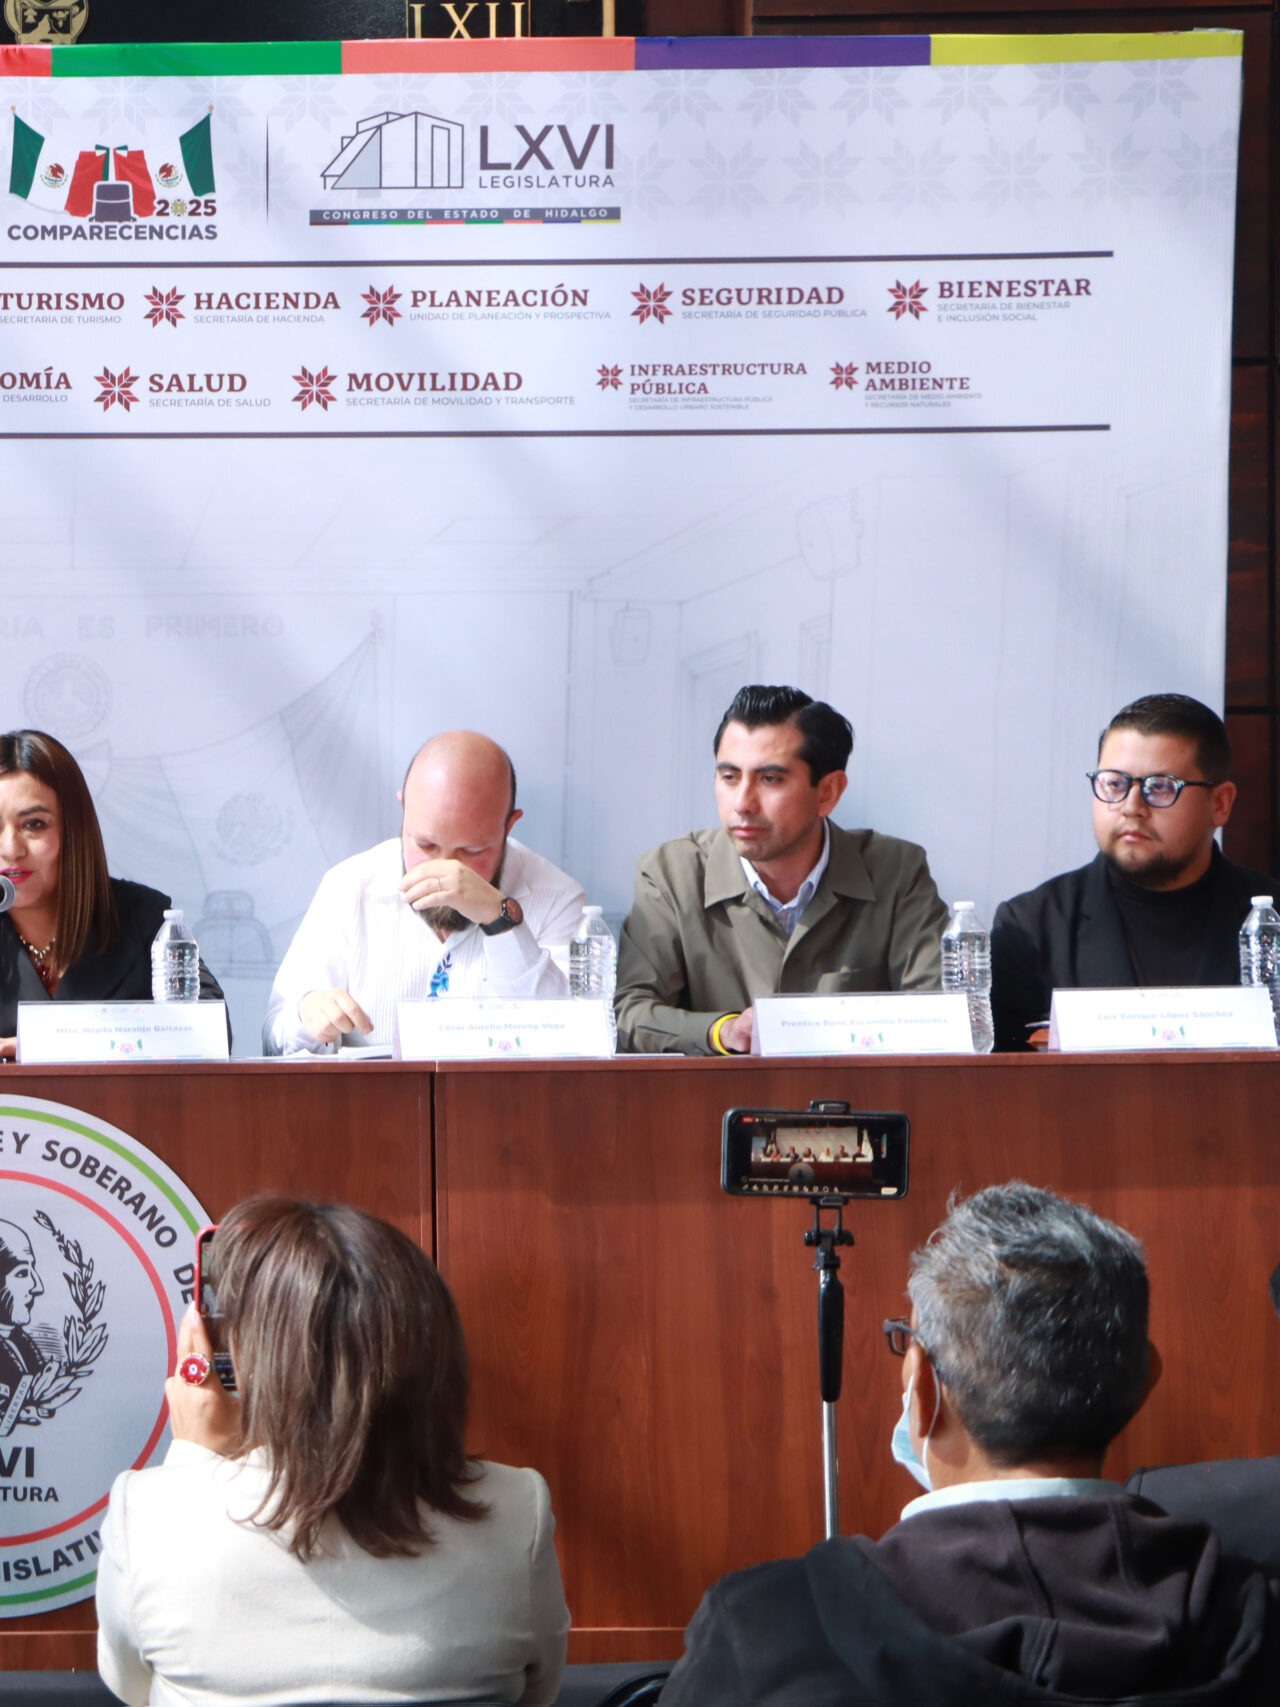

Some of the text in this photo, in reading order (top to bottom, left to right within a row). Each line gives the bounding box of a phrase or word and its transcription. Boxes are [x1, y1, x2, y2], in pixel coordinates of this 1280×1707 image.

[480, 124, 614, 171] LXVI
[479, 174, 615, 189] LEGISLATURA
[323, 208, 608, 220] CONGRESO DEL ESTADO DE HIDALGO
[7, 224, 218, 241] COMPARECENCIAS
[411, 283, 589, 308] PLANEACIÓN
[938, 278, 1092, 299] BIENESTAR
[194, 292, 341, 310] HACIENDA
[682, 286, 844, 306] SEGURIDAD
[937, 300, 1071, 312] SECRETARÍA DE BIENESTAR
[60, 315, 74, 324] DE
[76, 314, 122, 324] TURISMO
[193, 314, 325, 324] SECRETARÍA DE HACIENDA
[408, 311, 611, 322] UNIDAD DE PLANEACIÓN Y PROSPECTIVA
[681, 308, 867, 320] SECRETARÍA DE SEGURIDAD PÚBLICA
[937, 312, 1038, 323] E INCLUSIÓN SOCIAL
[630, 362, 807, 376] INFRAESTRUCTURA
[865, 361, 931, 374] MEDIO
[149, 373, 247, 393] SALUD
[346, 372, 522, 392] MOVILIDAD
[630, 378, 709, 395] PÚBLICA
[865, 377, 970, 391] AMBIENTE
[2, 394, 68, 403] DESARROLLO
[149, 397, 272, 408] SECRETARÍA DE SALUD
[345, 396, 575, 406] SECRETARÍA DE MOVILIDAD Y TRANSPORTE
[145, 614, 284, 638] PRIMERO
[11, 1131, 31, 1154] Y
[41, 1140, 177, 1249] SOBERANO
[5, 1381, 27, 1430] LIBERTAD
